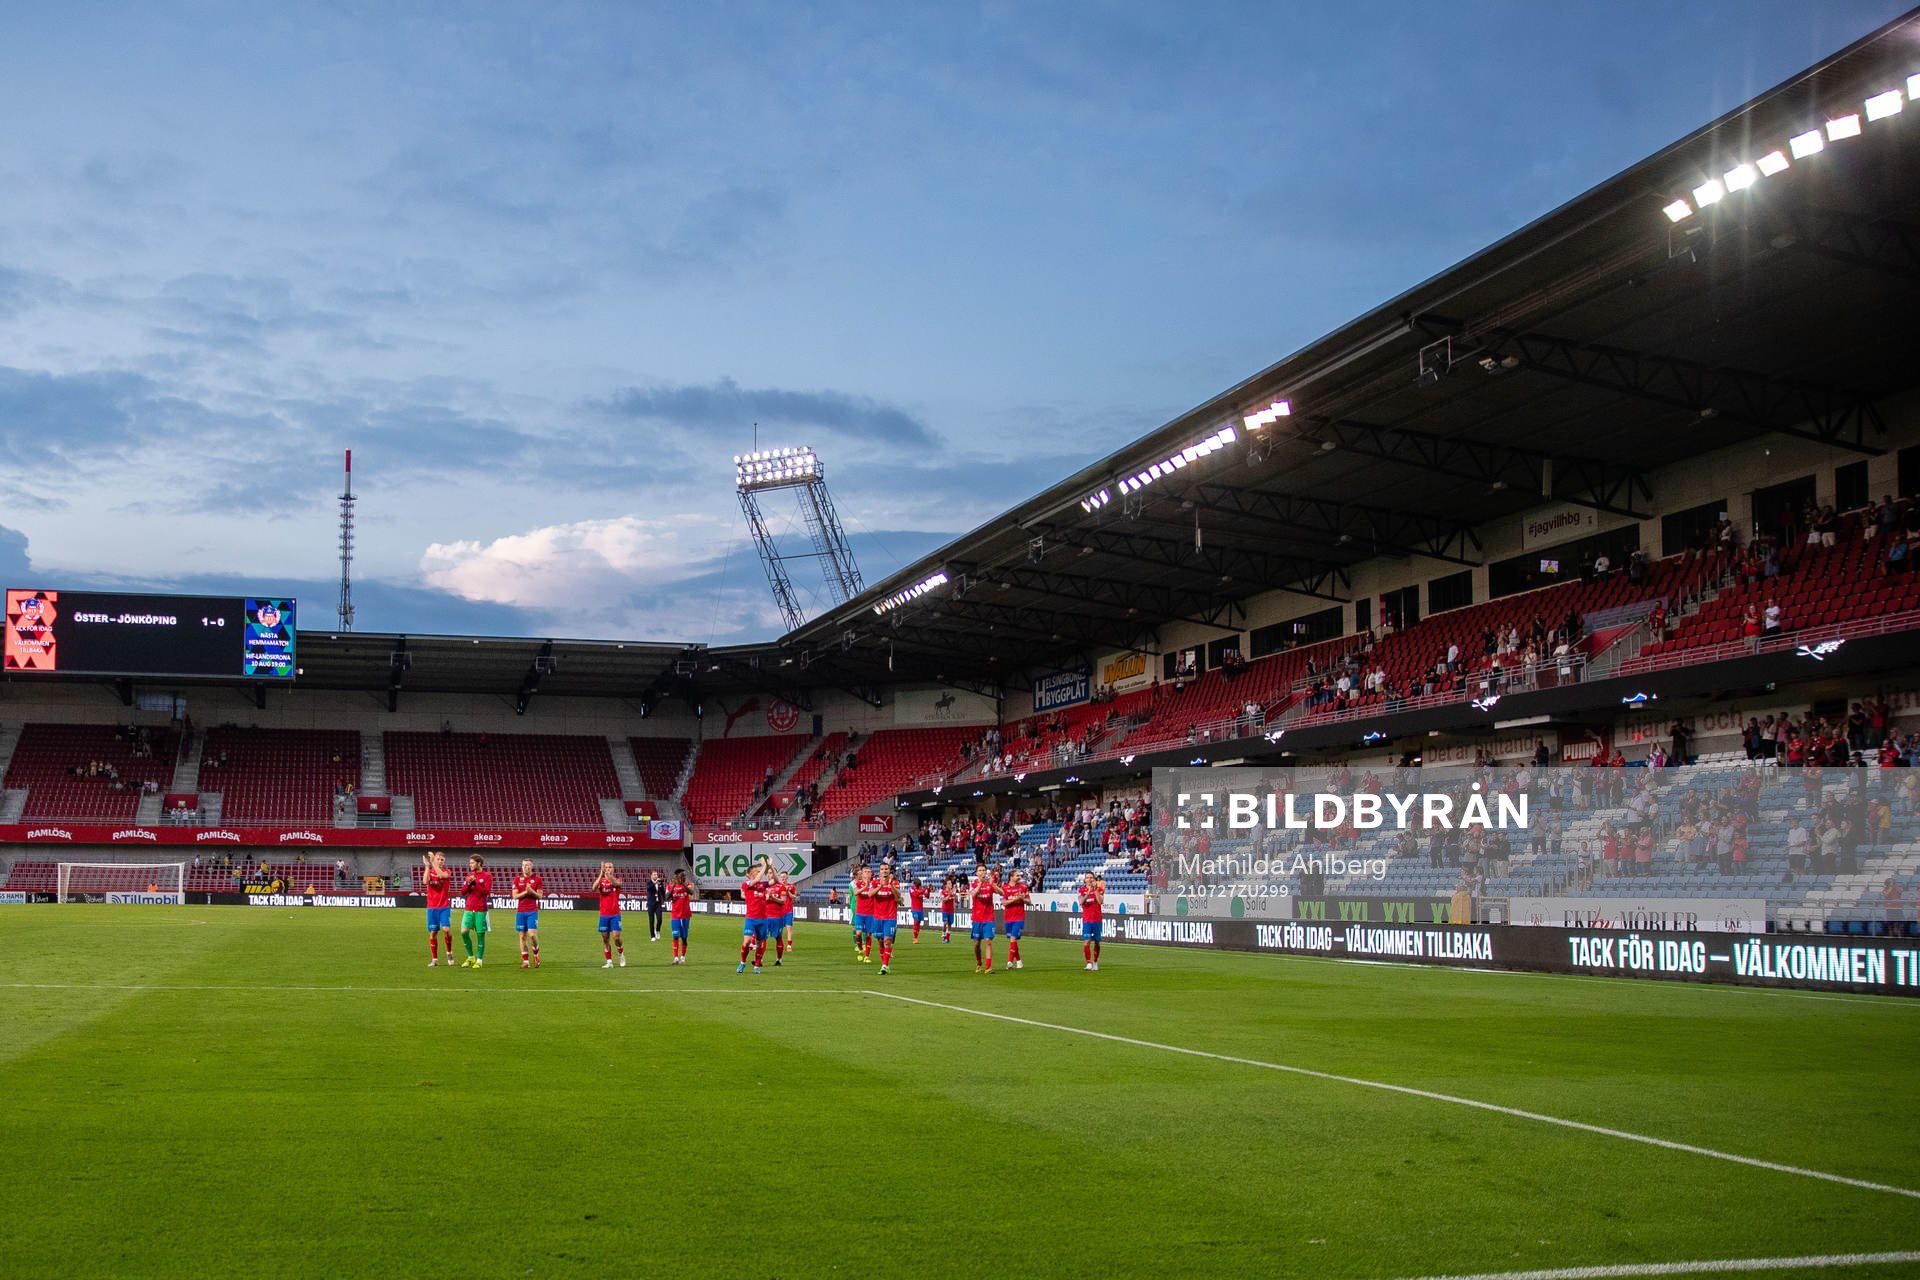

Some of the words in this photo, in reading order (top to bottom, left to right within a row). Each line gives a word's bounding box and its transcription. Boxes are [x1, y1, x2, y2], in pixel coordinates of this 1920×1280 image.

[1528, 511, 1581, 538] #jagvillhbg
[27, 827, 72, 840] RAMLÖSA
[860, 823, 884, 832] PUMA
[112, 828, 156, 841] RAMLÖSA
[196, 829, 240, 842] RAMLÖSA
[279, 830, 323, 843] RAMLÖSA
[406, 832, 426, 840] akea
[473, 833, 493, 841] akea
[540, 834, 560, 842] akea
[606, 834, 626, 842] akea
[707, 832, 743, 842] Scandic
[762, 831, 799, 841] Scandic
[6, 892, 24, 900] HAMN
[121, 894, 179, 904] Tillmobil
[249, 895, 268, 906] TACK
[270, 894, 285, 906] FÖR
[286, 895, 304, 906] IDAG
[312, 894, 359, 907] VÄLKOMMEN
[360, 896, 396, 908] TILLBAKA
[451, 896, 466, 909] FÖR
[539, 899, 574, 910] TILLBAKA
[627, 899, 641, 911] FÖR
[1620, 906, 1698, 932] MÖBLER
[1101, 918, 1116, 938] DAG
[1123, 917, 1172, 942] VÄLKOMMEN
[1172, 921, 1213, 944] TILLBAKA
[1256, 924, 1283, 948] TACK
[1284, 921, 1304, 949] FÖR
[1305, 926, 1332, 951] IDAG
[1345, 924, 1423, 956] VÄLKOMMEN
[1425, 931, 1493, 960] TILLBAKA
[1569, 936, 1615, 968] TACK
[1618, 933, 1654, 970] FÖR
[1659, 940, 1706, 973] IDAG
[1733, 938, 1886, 985] VÄLKOMMEN
[1891, 949, 1920, 987] TI
